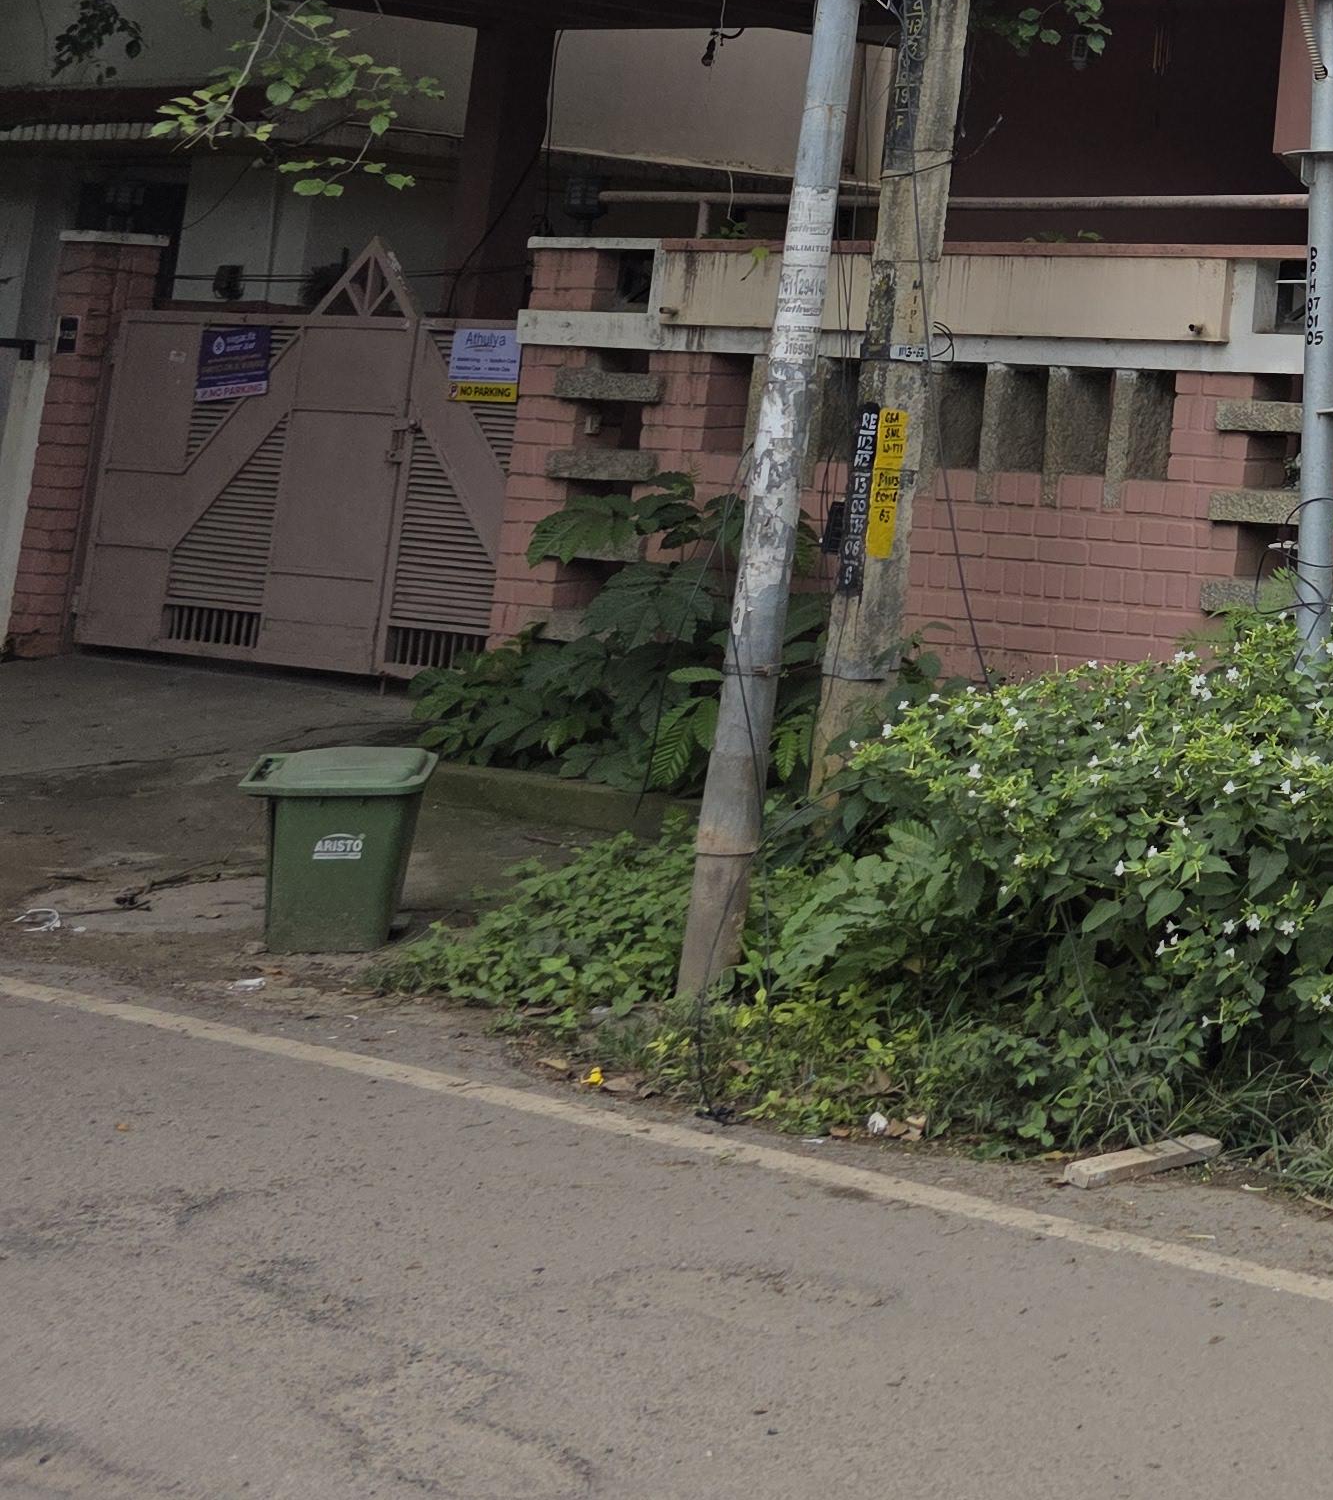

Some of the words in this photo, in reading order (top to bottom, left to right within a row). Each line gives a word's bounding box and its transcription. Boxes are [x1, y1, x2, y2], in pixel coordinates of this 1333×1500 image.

[465, 332, 507, 348] Athulya
[223, 383, 264, 396] PARKING
[460, 386, 473, 396] NO
[473, 386, 511, 398] PARKING
[861, 412, 878, 430] RE
[314, 840, 363, 852] ARISTO
